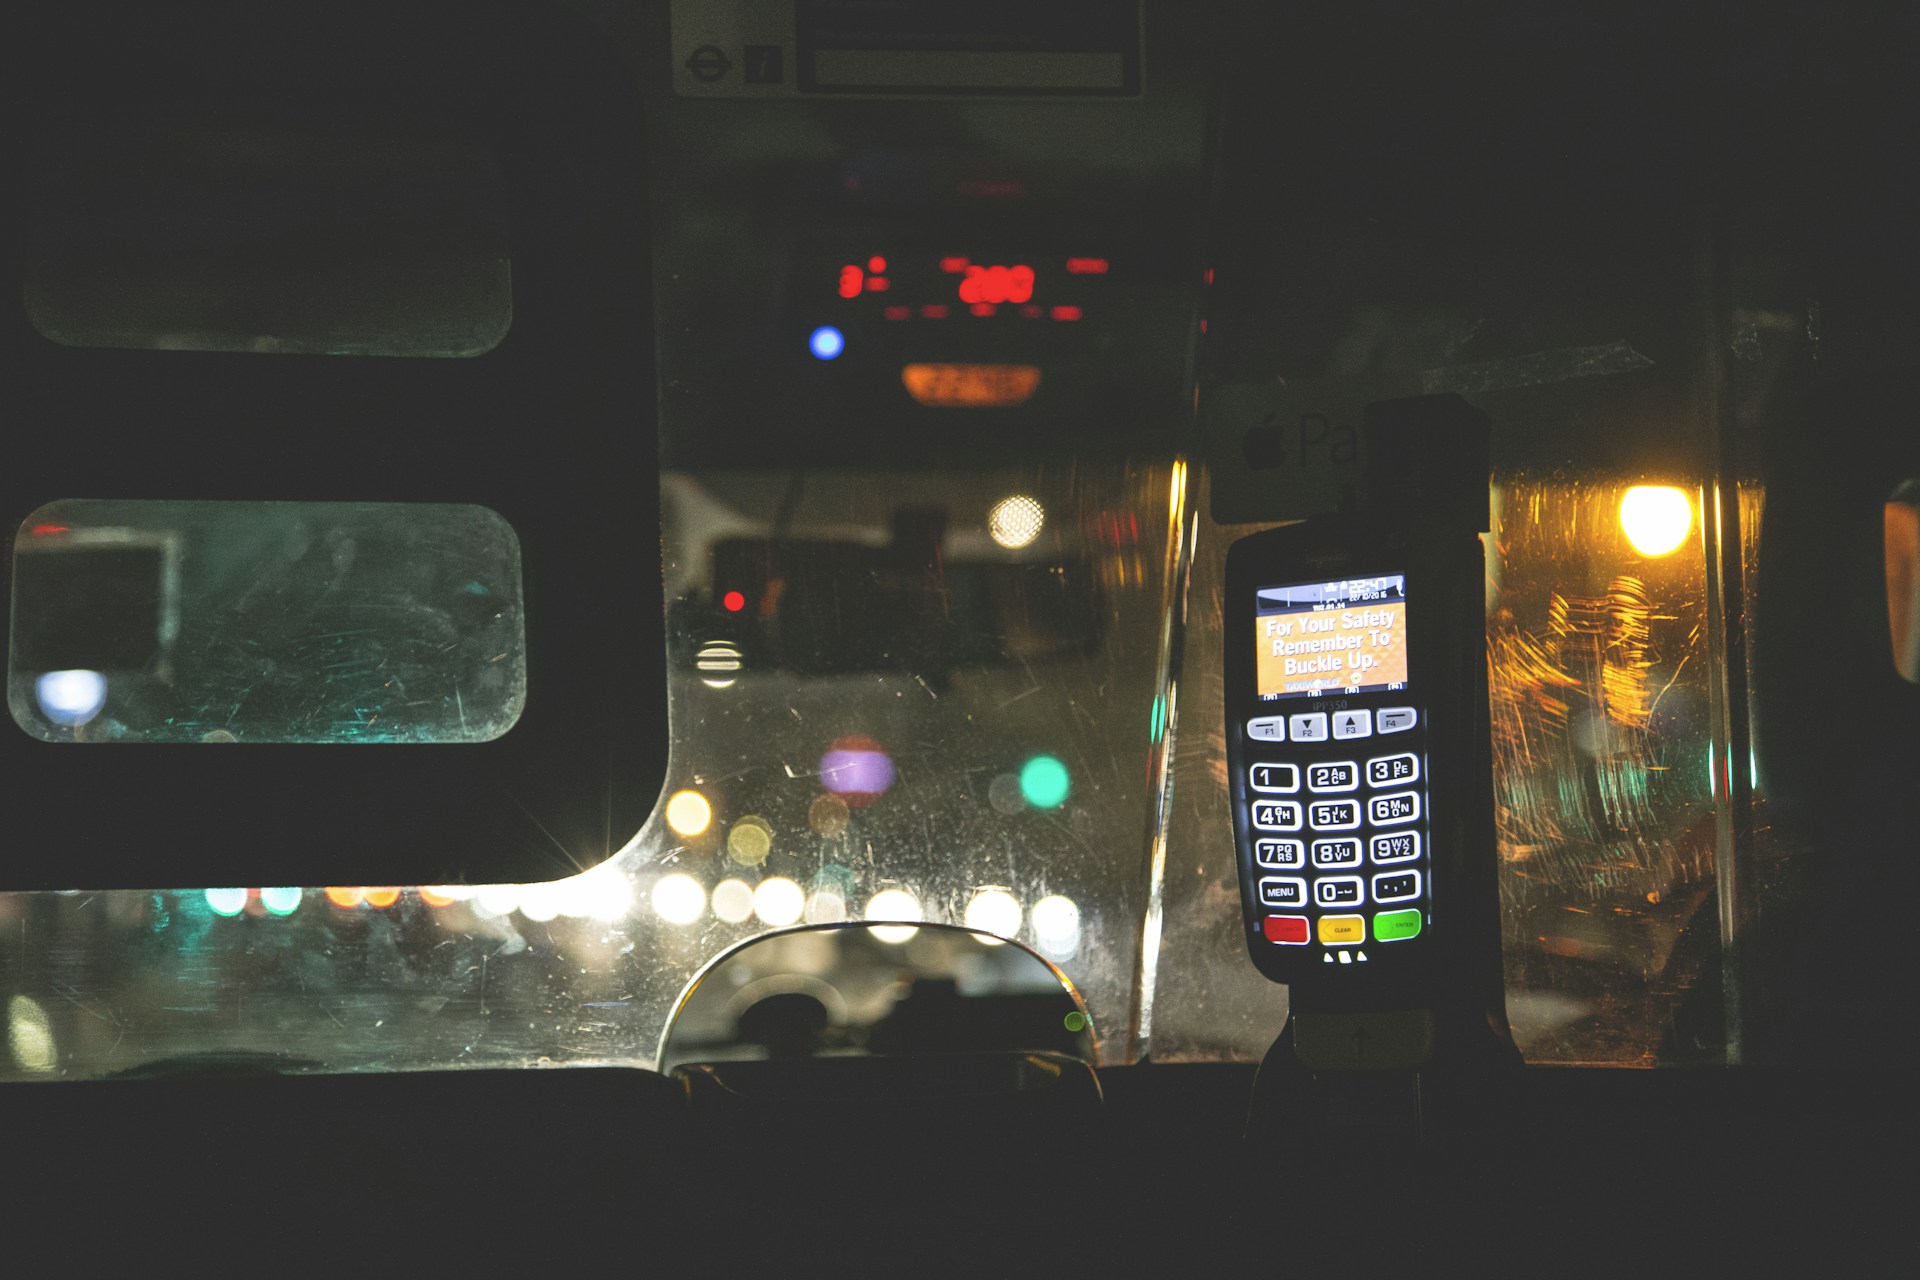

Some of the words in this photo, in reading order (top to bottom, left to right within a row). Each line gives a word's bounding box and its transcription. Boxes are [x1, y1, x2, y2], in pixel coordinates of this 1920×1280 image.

[1302, 413, 1357, 467] Pa
[1349, 577, 1387, 594] 22:47
[1266, 620, 1294, 638] For
[1298, 616, 1337, 634] Your
[1341, 609, 1396, 630] Safety
[1272, 633, 1364, 657] Remember
[1368, 629, 1391, 647] To
[1284, 654, 1343, 676] Buckle
[1348, 651, 1379, 672] Up.
[1345, 726, 1356, 734] F3
[1385, 720, 1396, 728] F4
[1302, 729, 1313, 737] F2
[1259, 768, 1270, 785] 1
[1317, 769, 1329, 786] 2
[1375, 762, 1389, 779] 3
[1260, 807, 1274, 824] 4
[1318, 807, 1331, 824] 5
[1376, 801, 1390, 818] 6
[1262, 845, 1275, 862] 7
[1320, 845, 1333, 862] 8
[1377, 840, 1391, 857] 9
[1267, 887, 1294, 897] MENU
[1322, 884, 1337, 901] 0
[1395, 921, 1414, 929] ENTER
